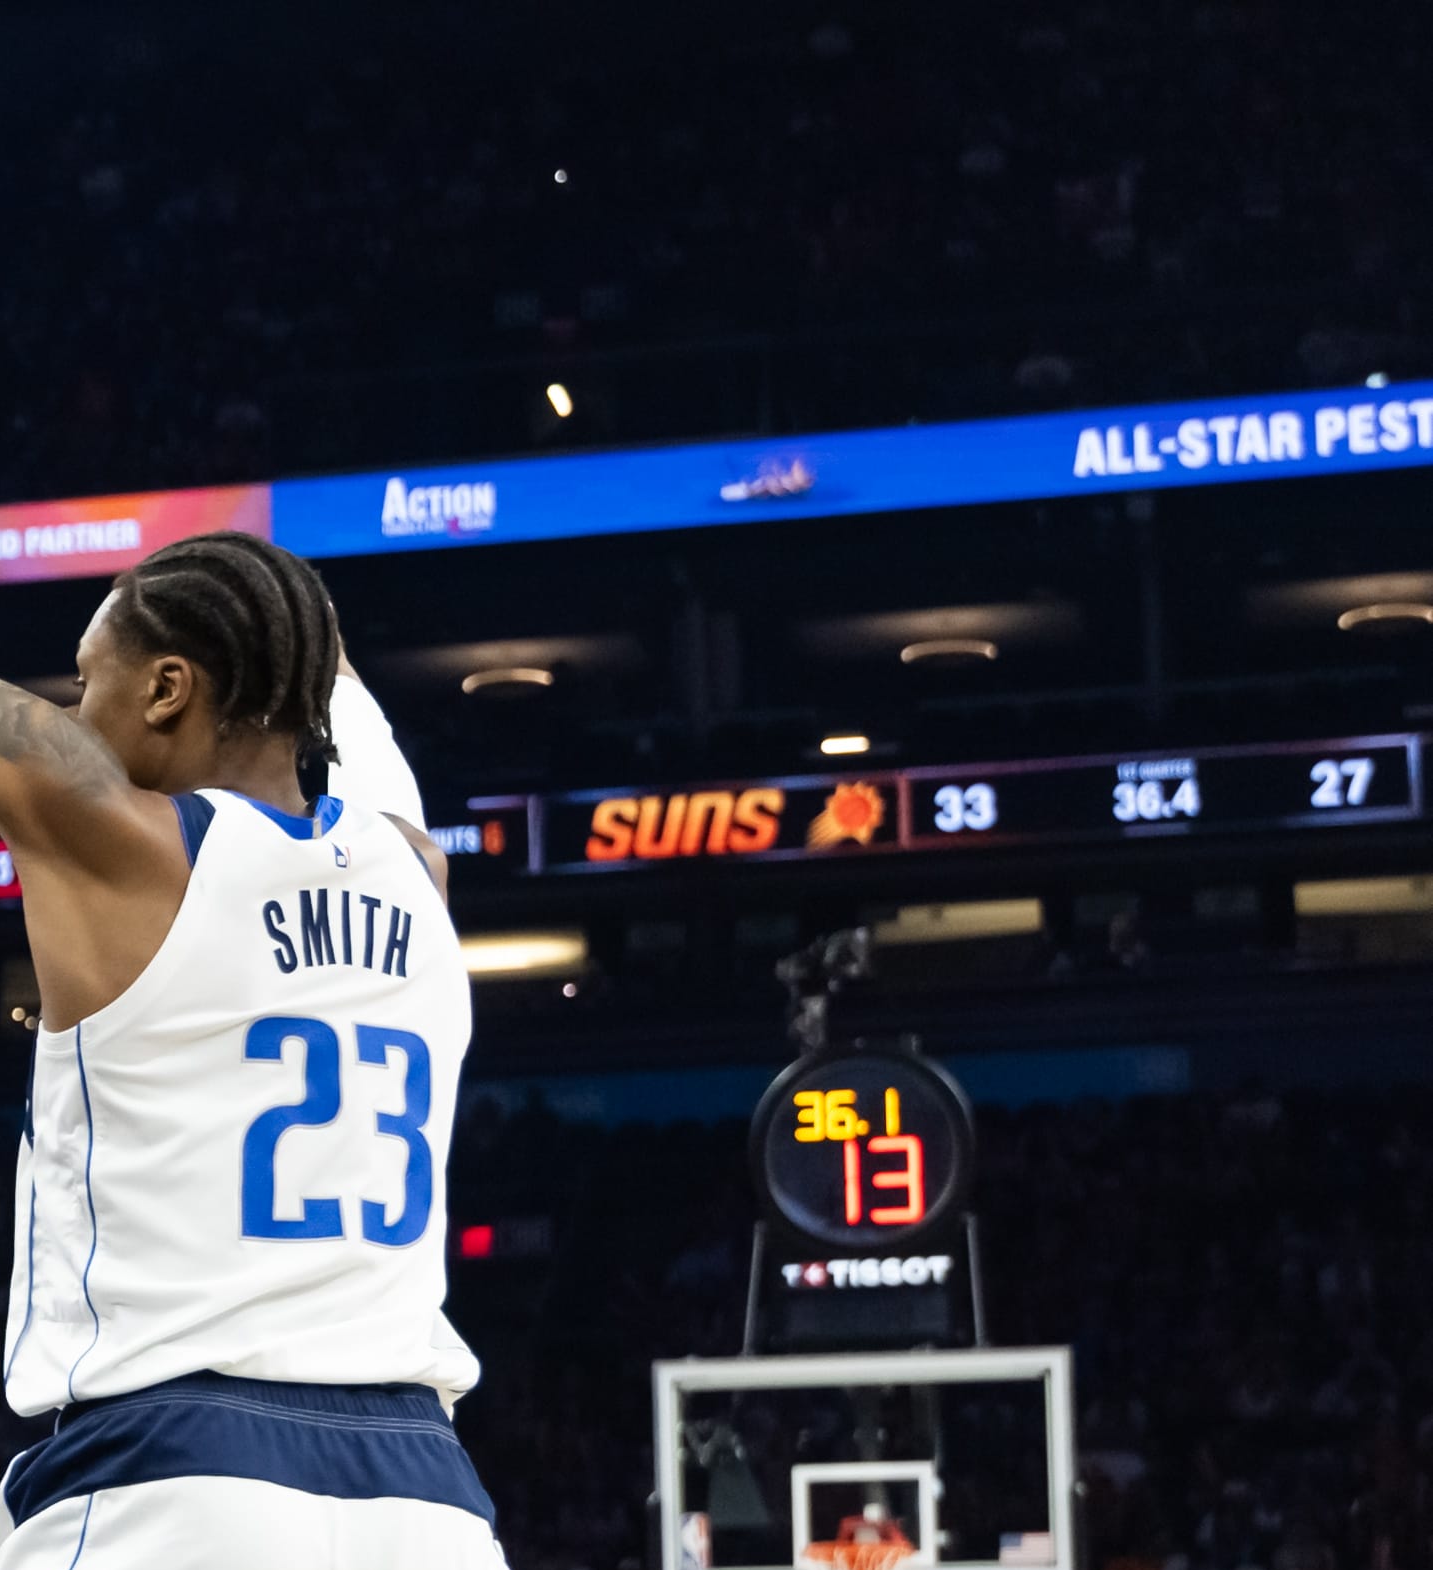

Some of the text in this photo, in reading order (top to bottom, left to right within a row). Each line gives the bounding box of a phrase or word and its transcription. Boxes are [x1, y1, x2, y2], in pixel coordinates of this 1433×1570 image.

[1073, 398, 1433, 478] ALL-STAR PEST
[24, 517, 141, 559] PARTNER
[933, 782, 998, 833] 33
[1112, 778, 1202, 822] 36.4
[1309, 757, 1375, 808] 27
[585, 787, 786, 863] SUNS
[262, 887, 413, 979] SMITH
[238, 1012, 434, 1250] 23
[792, 1085, 902, 1144] 36.1
[843, 1134, 925, 1227] 13
[825, 1254, 955, 1289] TISSOT
